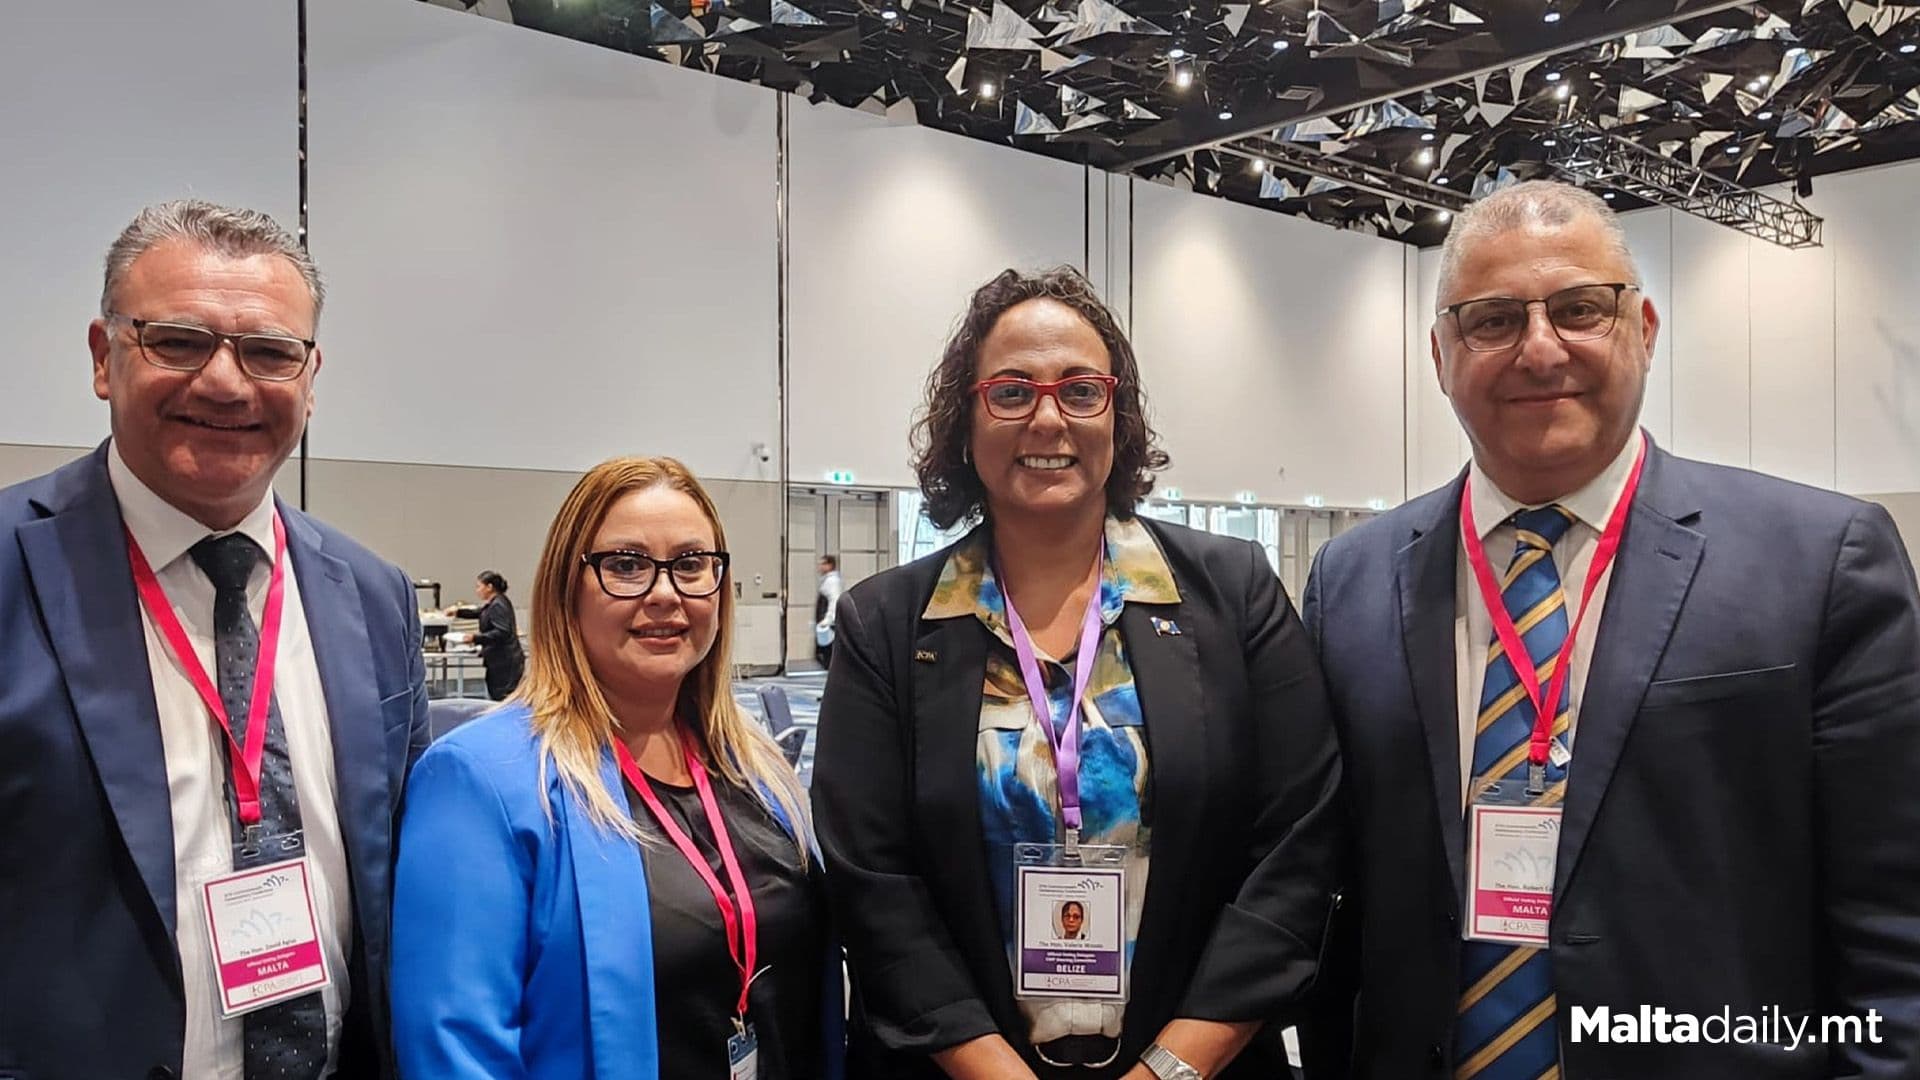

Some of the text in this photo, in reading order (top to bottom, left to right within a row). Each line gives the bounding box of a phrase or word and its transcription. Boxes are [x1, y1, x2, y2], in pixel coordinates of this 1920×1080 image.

[1512, 905, 1548, 916] MALTA
[257, 960, 290, 977] MALTA
[1056, 964, 1087, 973] BELIZE
[1051, 977, 1071, 986] CPA
